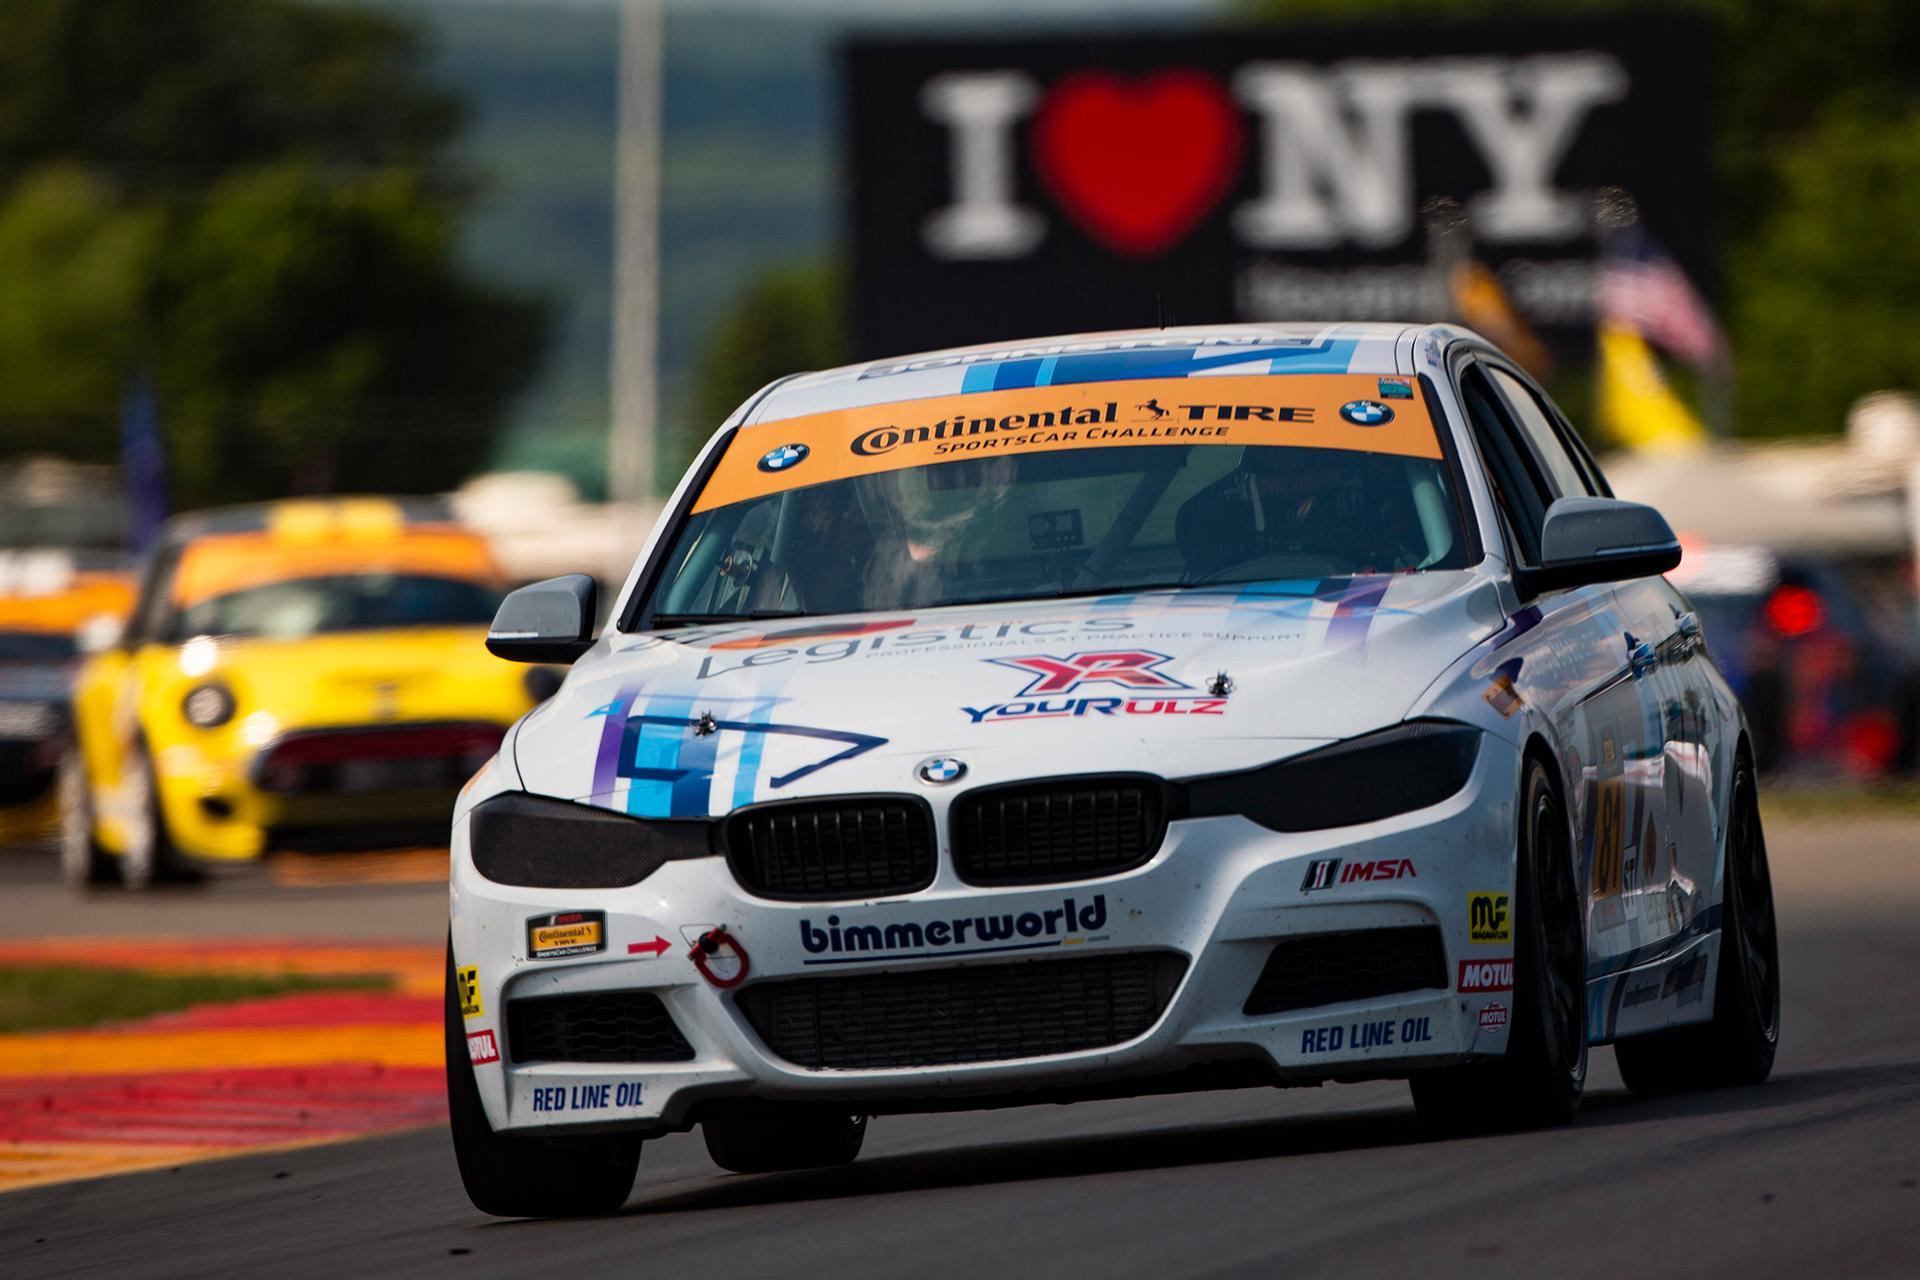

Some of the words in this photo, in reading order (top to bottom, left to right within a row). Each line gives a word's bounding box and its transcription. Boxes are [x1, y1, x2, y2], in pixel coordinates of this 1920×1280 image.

[920, 70, 1046, 260] I
[1232, 54, 1627, 248] NY
[850, 402, 1119, 456] Continental
[1178, 404, 1316, 424] TIRE
[1086, 426, 1230, 440] CHALLENGE
[866, 638, 1041, 658] PROFESSIONALS
[1054, 635, 1077, 643] AT
[1087, 632, 1195, 641] PRACTICE
[1201, 631, 1306, 642] SUPPORT
[1340, 858, 1418, 883] IMSA
[800, 895, 1107, 954] bimmerworld
[1480, 1010, 1506, 1024] MOTUL
[1301, 1025, 1344, 1054] RED
[1350, 1020, 1396, 1048] LINE
[1401, 1016, 1432, 1043] OIL
[533, 1087, 566, 1112] RED
[571, 1084, 612, 1110] LINE
[616, 1081, 643, 1107] OIL
